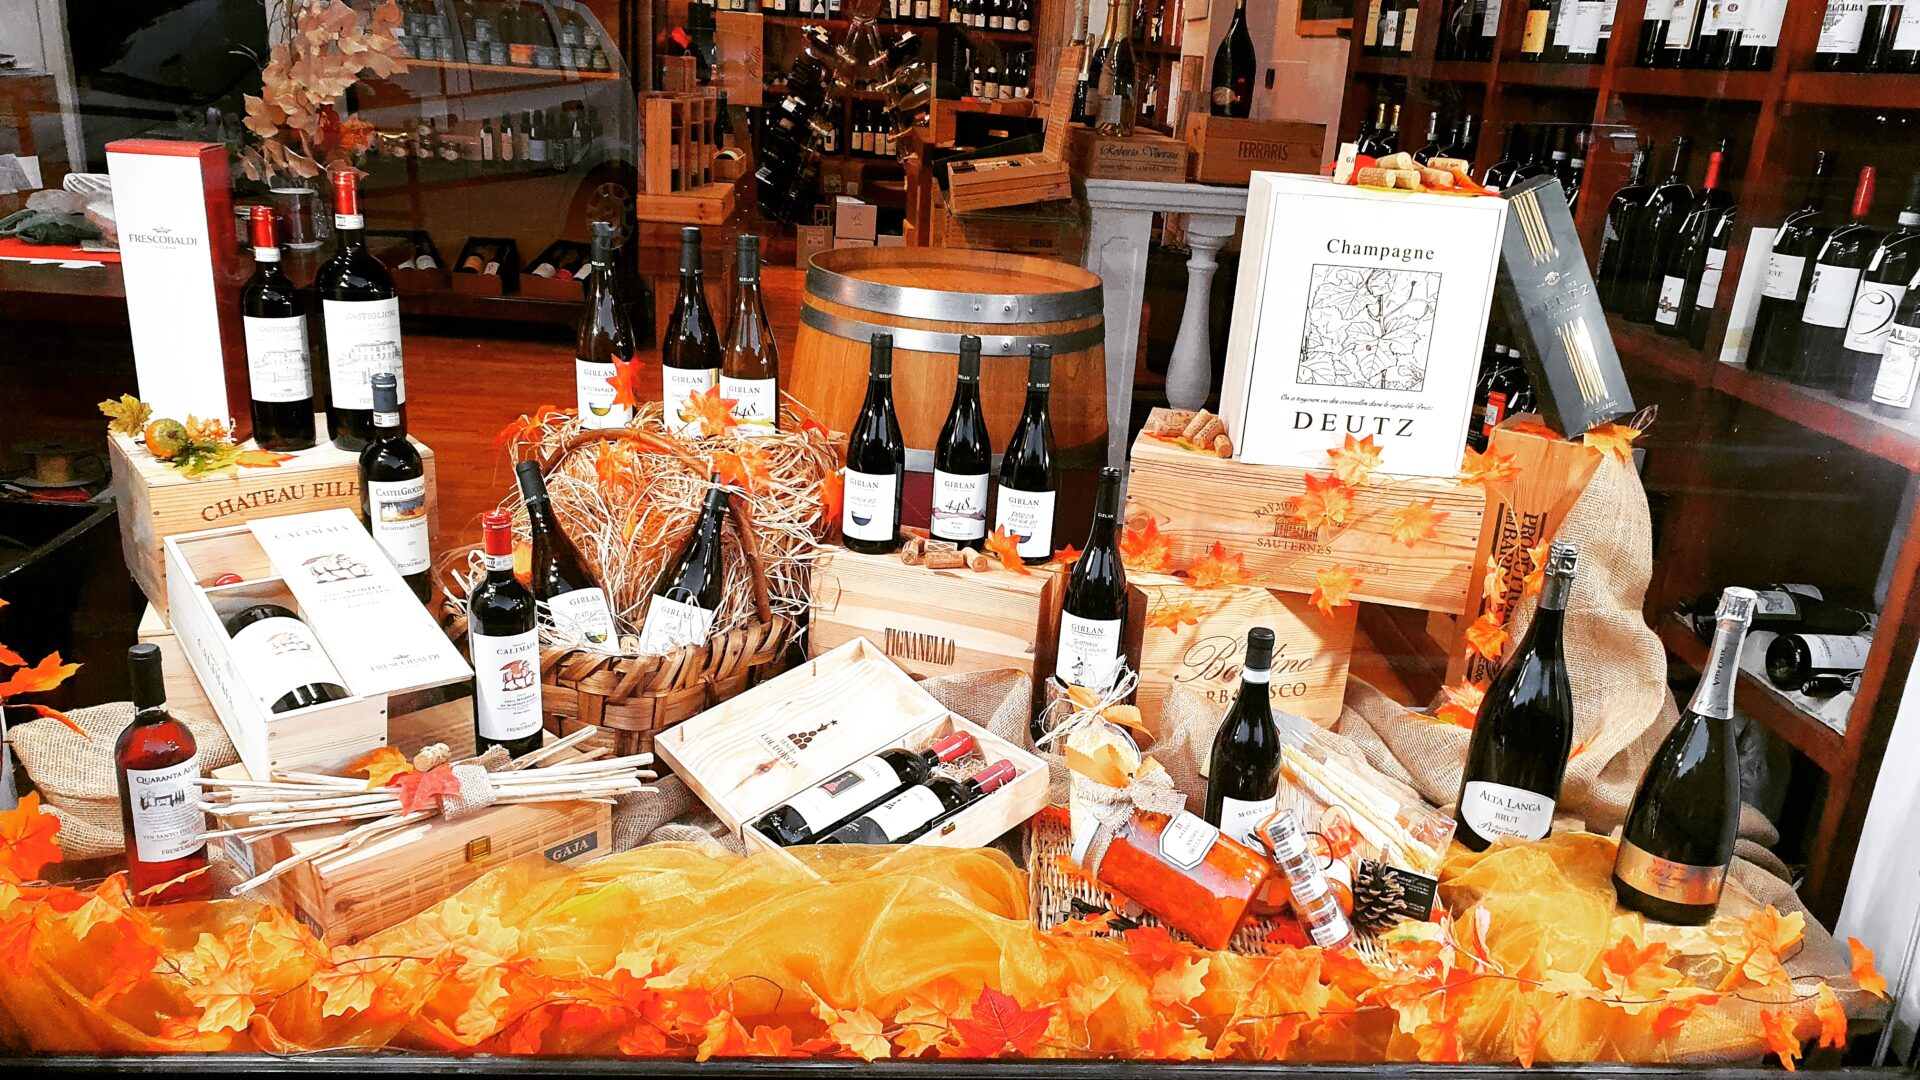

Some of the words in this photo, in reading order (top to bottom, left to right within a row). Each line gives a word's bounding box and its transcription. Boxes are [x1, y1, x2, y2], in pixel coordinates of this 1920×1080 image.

[1238, 142, 1288, 160] FERRARIS
[128, 233, 198, 246] FRESCOBALDI
[1326, 238, 1435, 262] Champagne
[584, 369, 615, 377] GIRLAN
[672, 376, 704, 384] GIRLAN
[729, 386, 761, 394] GIRLAN
[1292, 411, 1415, 437] DEUTZ
[850, 477, 879, 488] GIRLAN
[944, 480, 976, 489] GIRLAN
[200, 484, 305, 522] CHATEAU
[313, 481, 360, 498] FILH
[1008, 496, 1040, 506] GIRLAN
[1256, 537, 1332, 556] SAUTERNES
[569, 595, 601, 606] GIRLAN
[661, 606, 695, 620] GIRLAN
[1071, 623, 1104, 635] GIRLAN
[496, 641, 536, 655] CALIMAIA
[884, 627, 956, 667] TIGNANELLO
[370, 653, 440, 672] FRESCOBALDI
[760, 733, 775, 747] COL
[136, 772, 182, 785] QUARANTA
[1479, 790, 1503, 806] ALTA
[1507, 798, 1541, 812] LANGA
[1238, 804, 1274, 818] MOCCA
[1494, 812, 1519, 824] BRUT
[552, 839, 590, 861] GAJA
